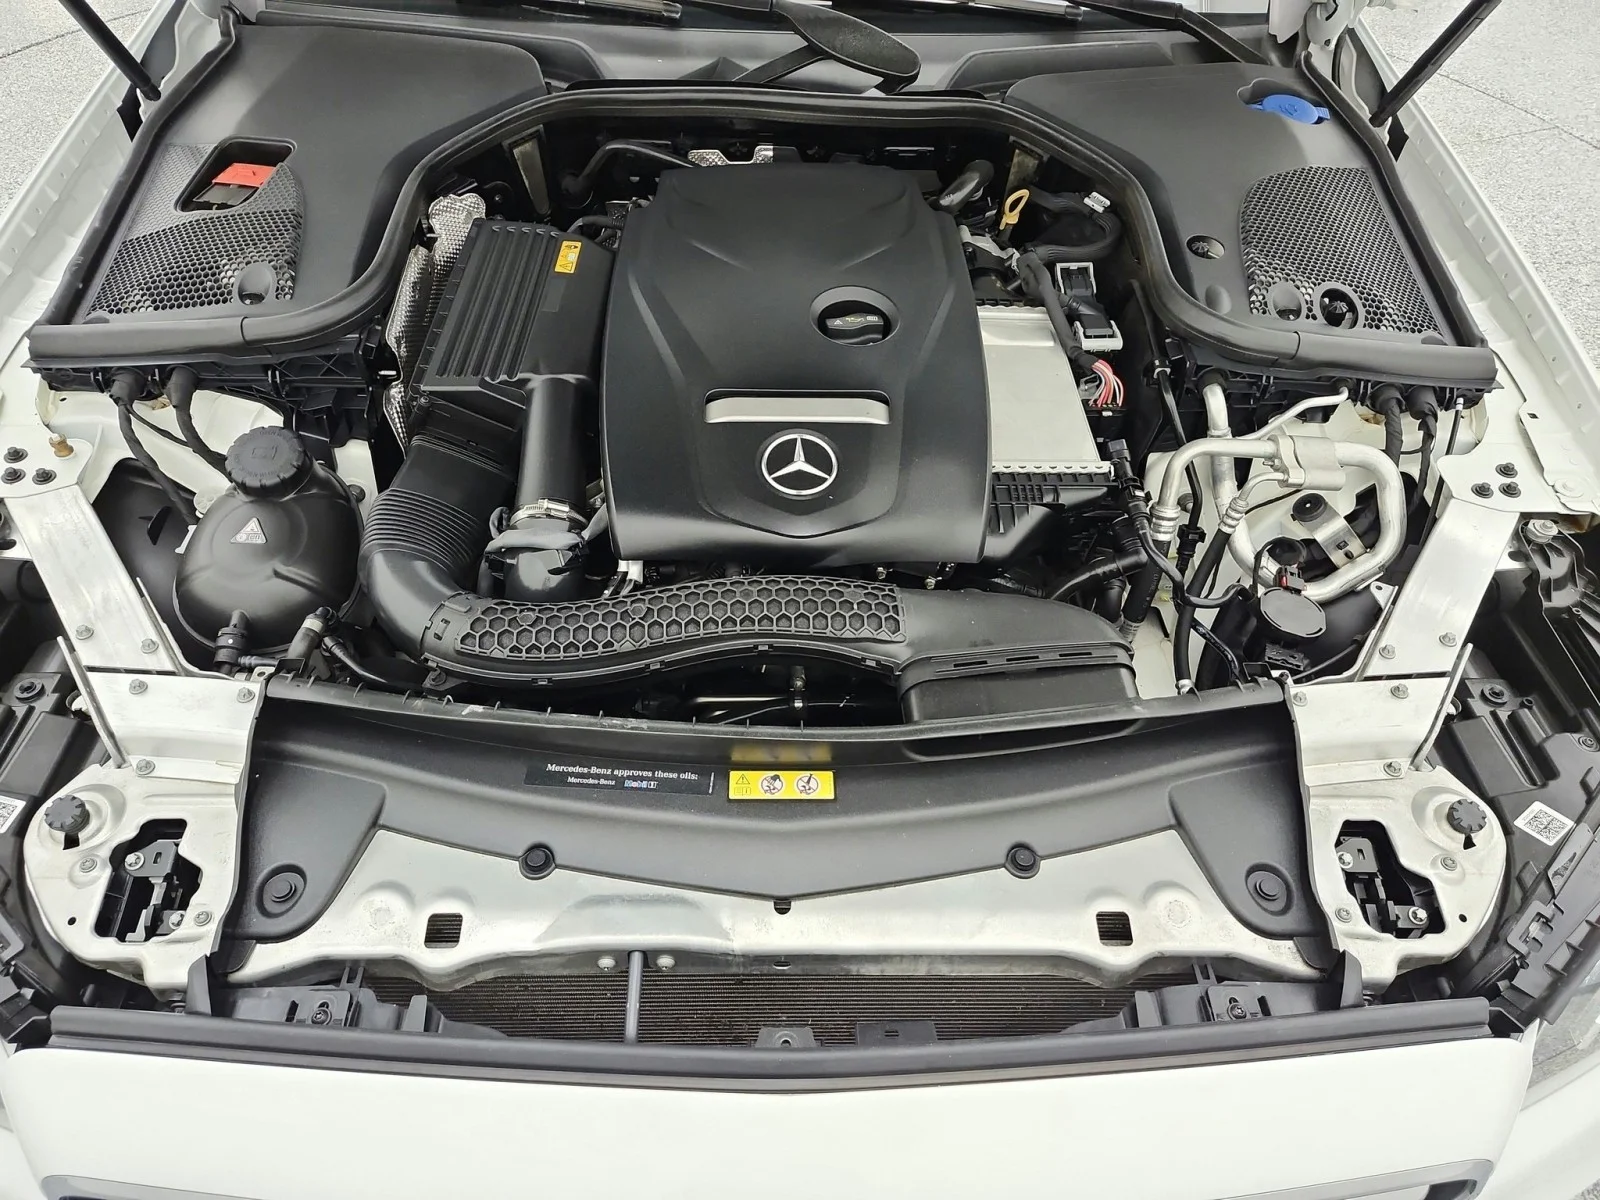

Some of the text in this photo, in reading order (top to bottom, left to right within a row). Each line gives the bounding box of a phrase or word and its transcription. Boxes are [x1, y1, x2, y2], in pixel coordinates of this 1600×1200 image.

[546, 763, 612, 775] Mercedes-Benz
[613, 768, 653, 777] approves
[654, 770, 678, 779] these
[567, 776, 616, 786] Mercedes-Benz
